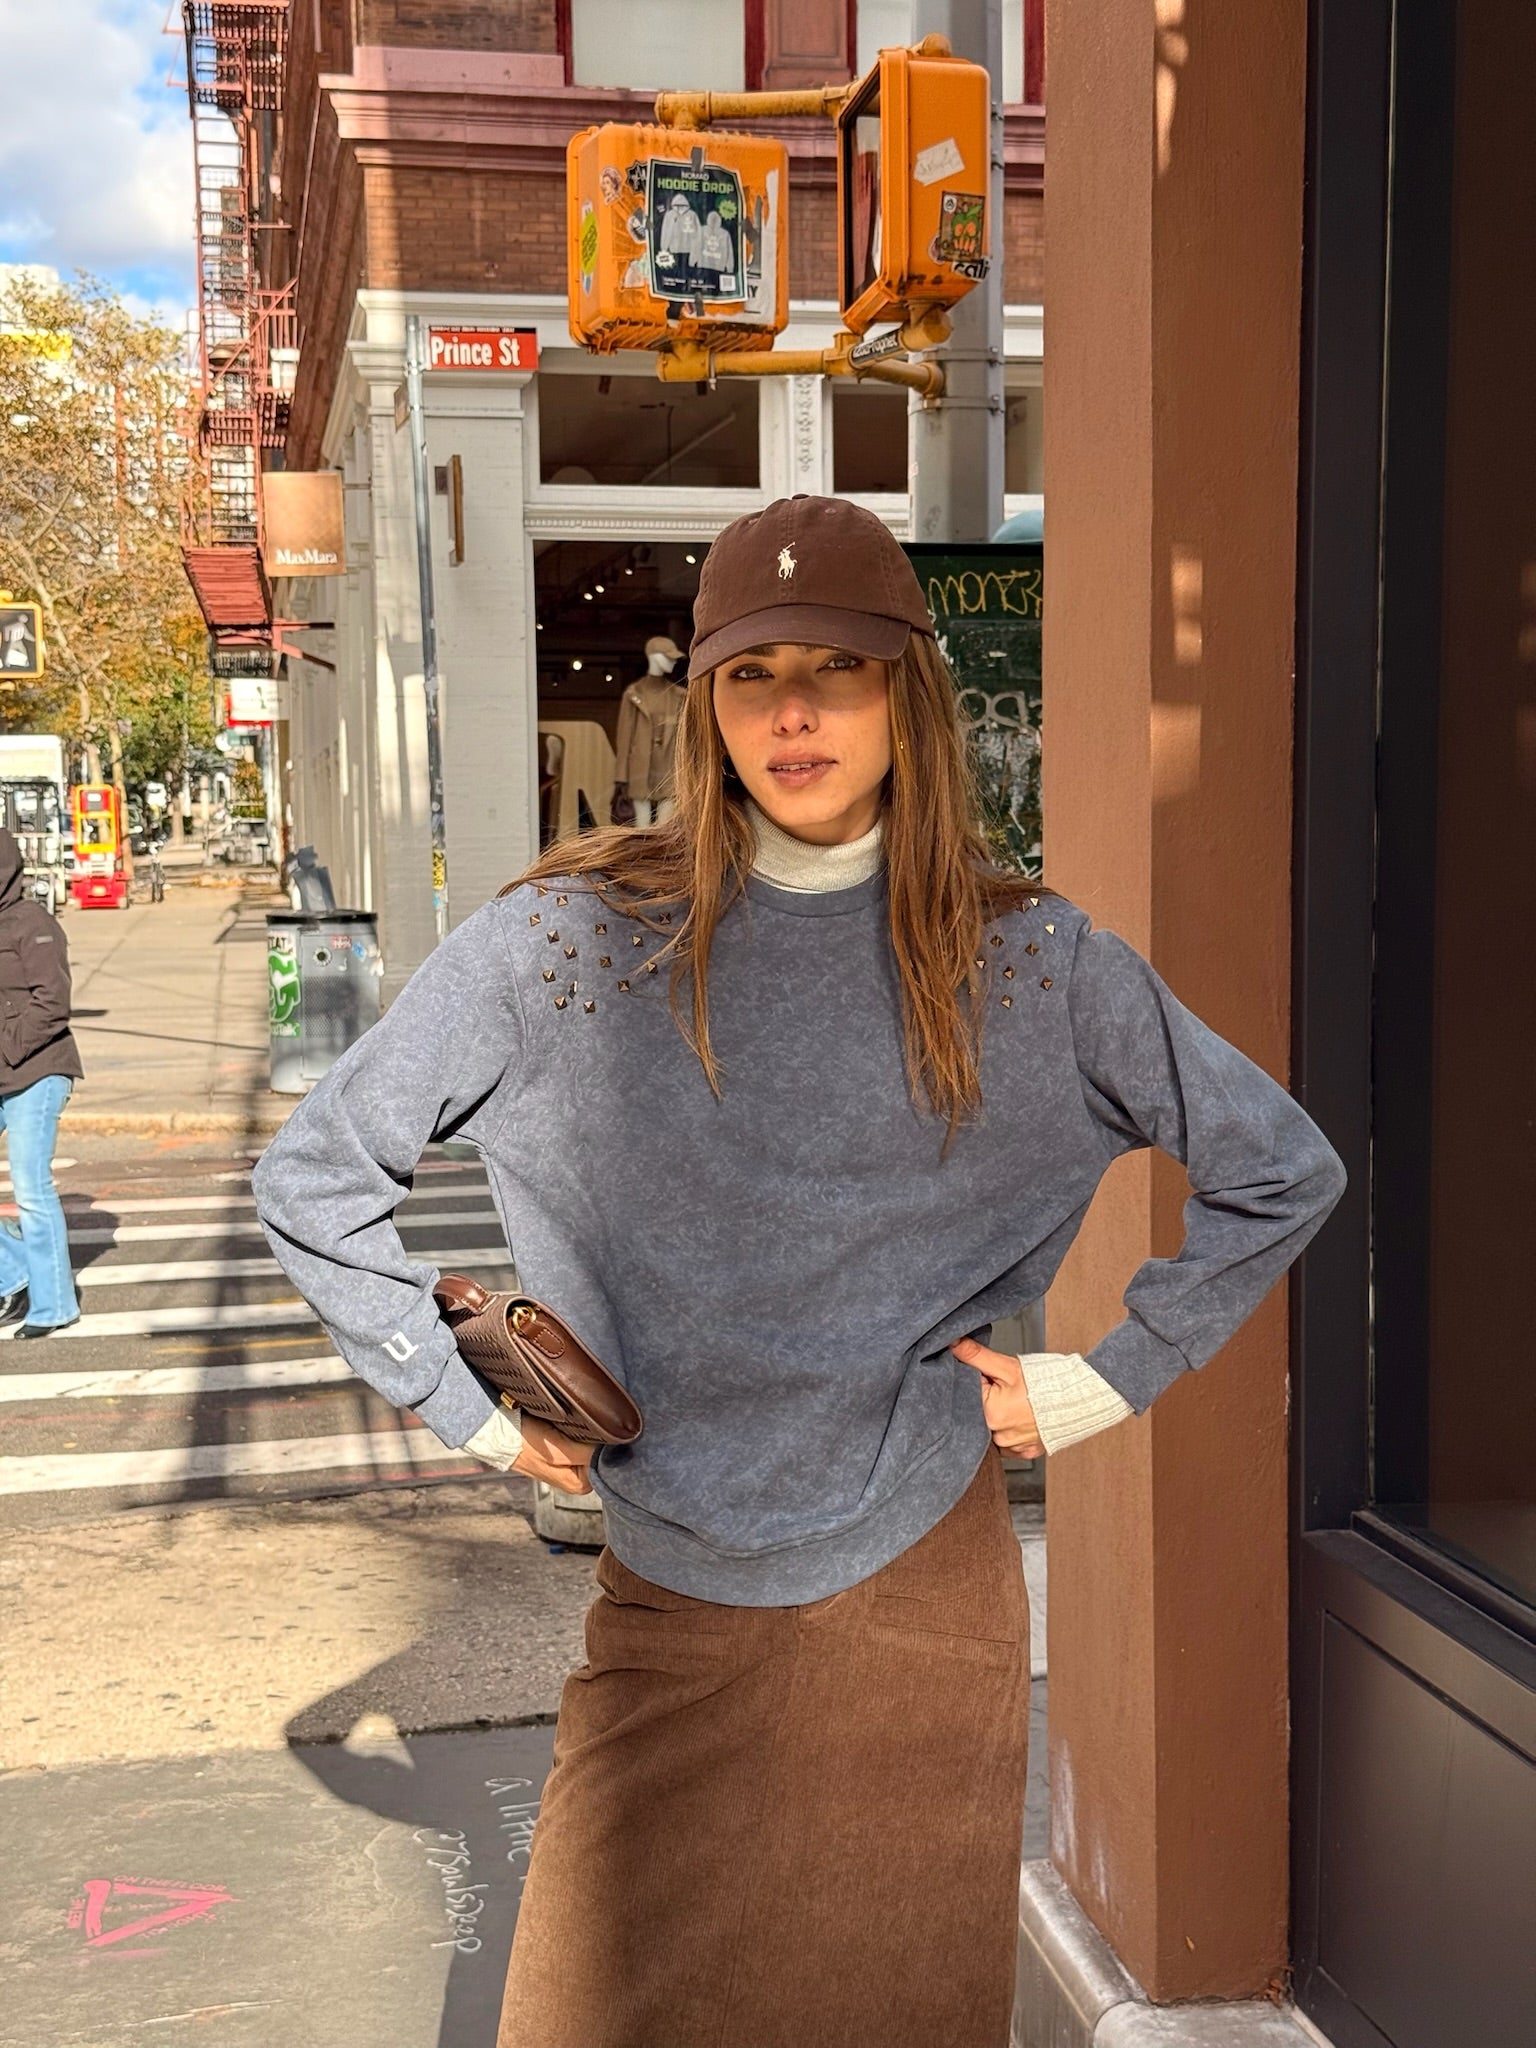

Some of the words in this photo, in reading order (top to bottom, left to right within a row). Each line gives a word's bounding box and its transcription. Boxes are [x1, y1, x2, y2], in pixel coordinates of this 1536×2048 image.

[657, 177, 700, 192] HOODIE
[702, 181, 735, 194] DROP
[430, 335, 493, 367] Prince
[498, 336, 521, 367] St
[275, 548, 339, 565] MaxMara
